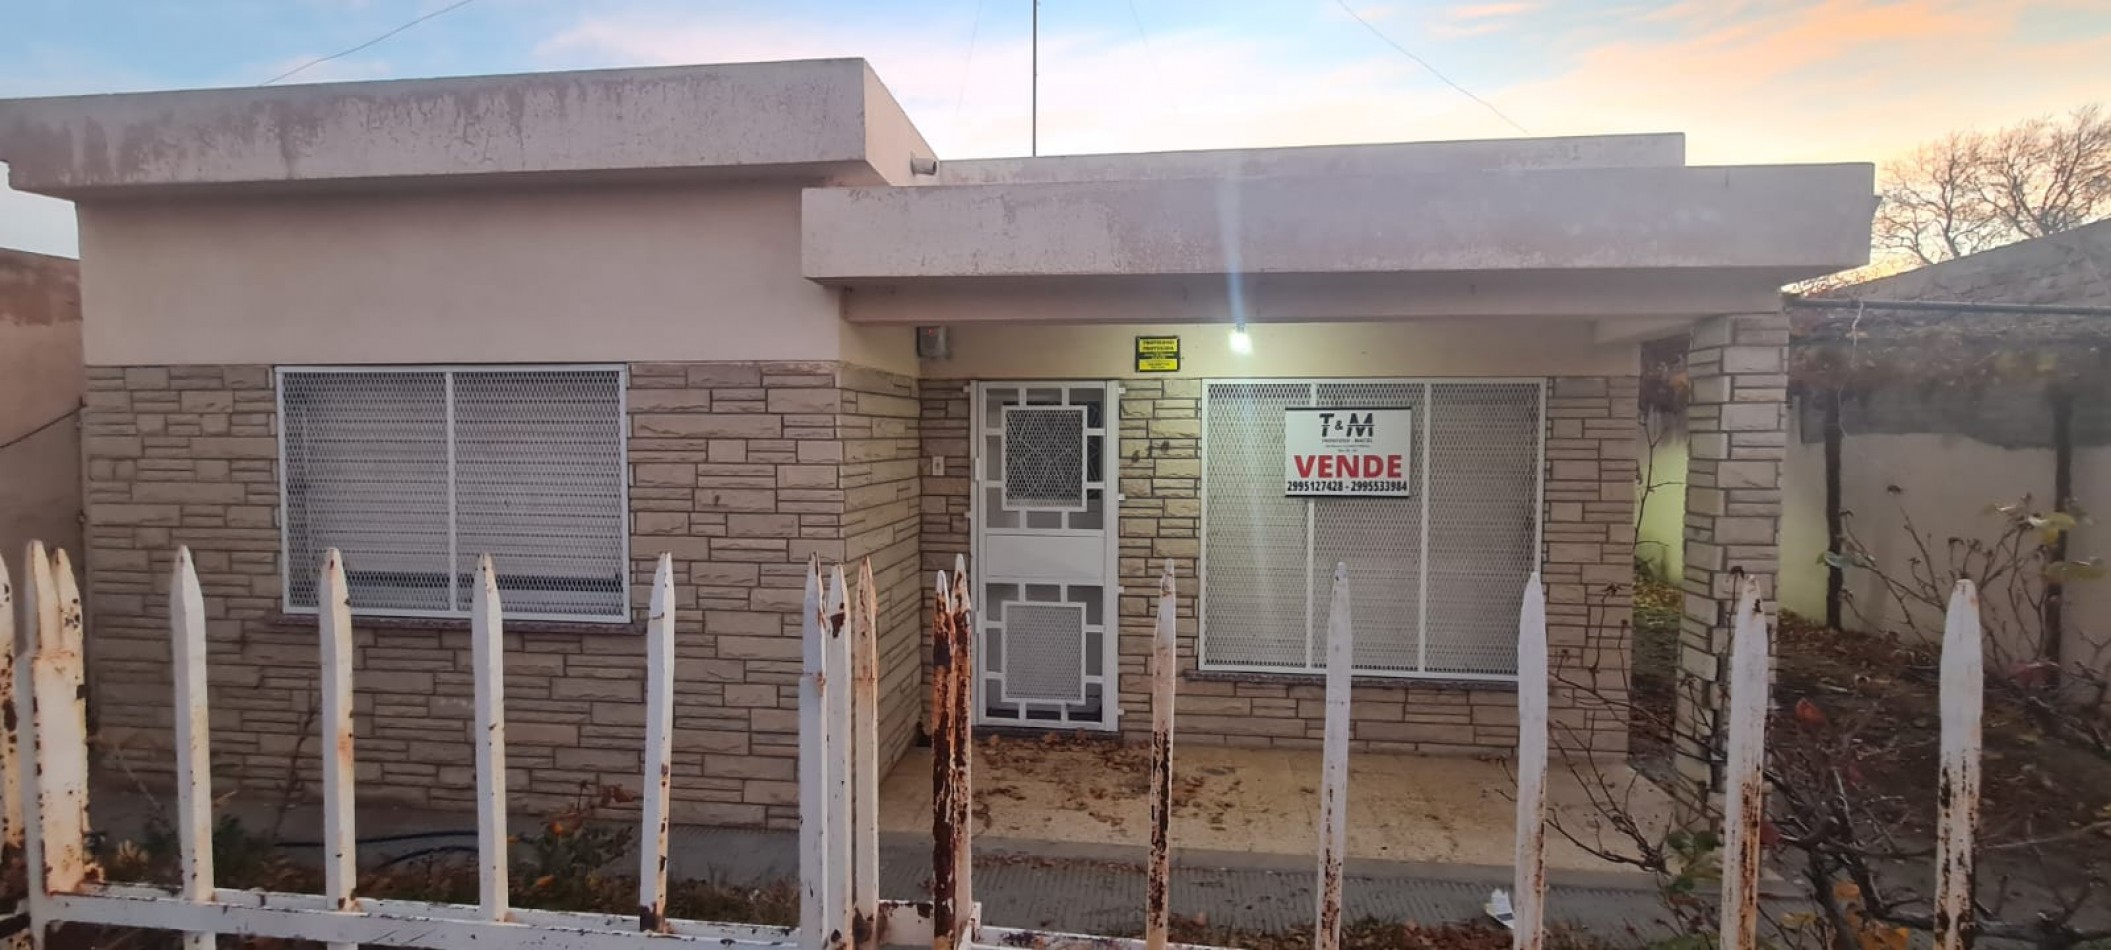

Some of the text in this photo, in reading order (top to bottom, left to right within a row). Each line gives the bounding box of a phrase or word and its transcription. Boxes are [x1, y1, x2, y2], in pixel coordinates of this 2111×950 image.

[1294, 455, 1402, 478] VENDE
[1287, 481, 1343, 492] 2995127428
[1351, 481, 1407, 492] 2995533984
